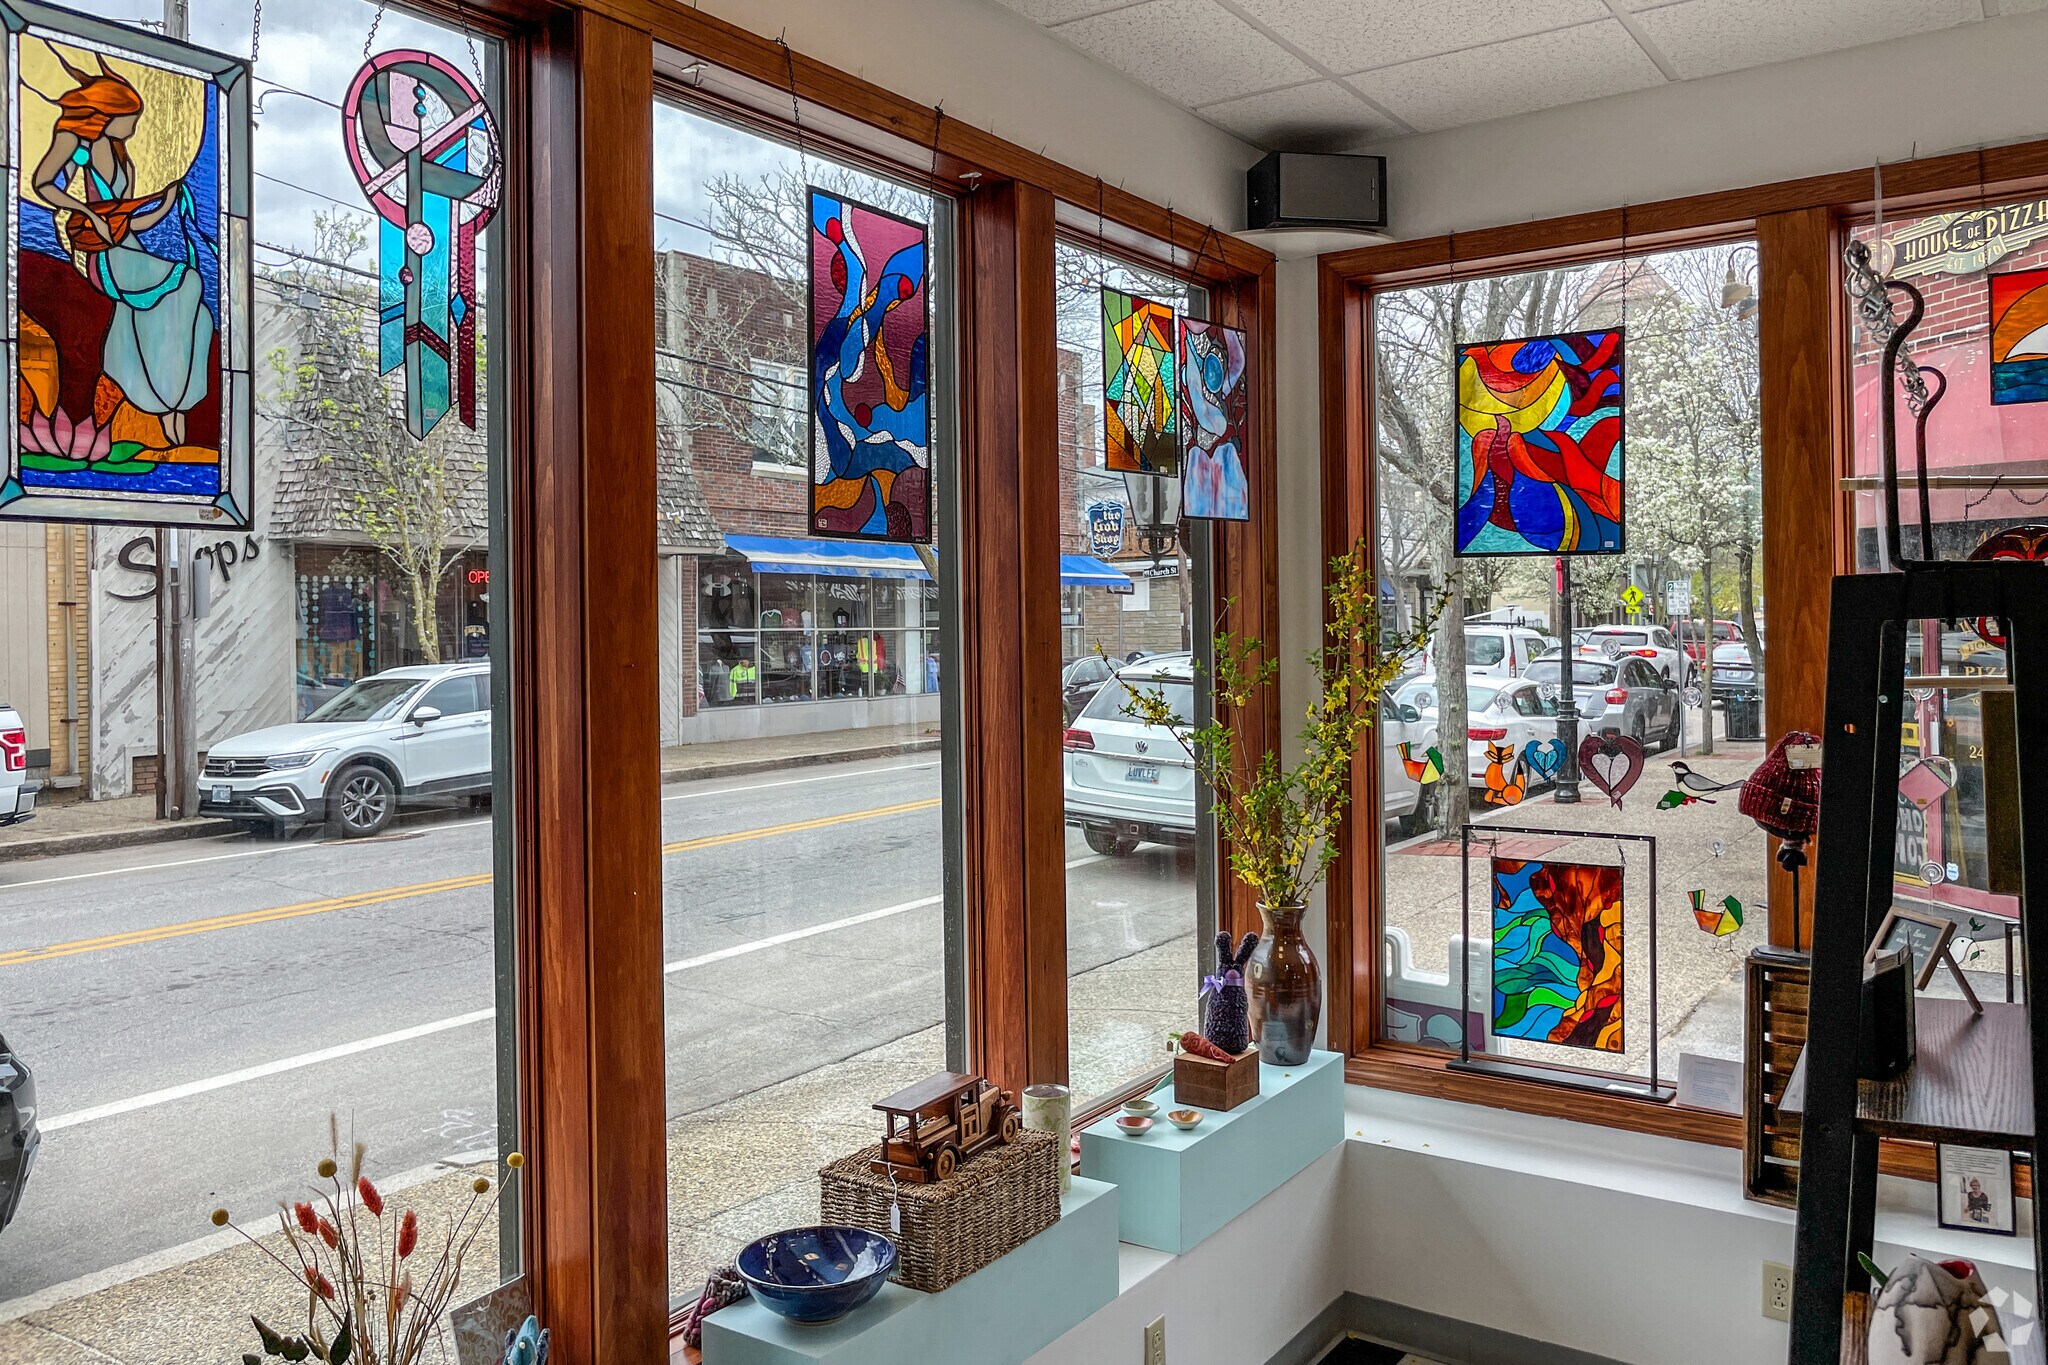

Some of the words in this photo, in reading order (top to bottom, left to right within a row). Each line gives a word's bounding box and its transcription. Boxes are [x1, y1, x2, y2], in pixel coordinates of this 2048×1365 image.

[1904, 226, 1961, 262] HOUSE
[1968, 226, 1981, 239] OF
[1149, 567, 1170, 577] Church
[1170, 566, 1178, 575] St
